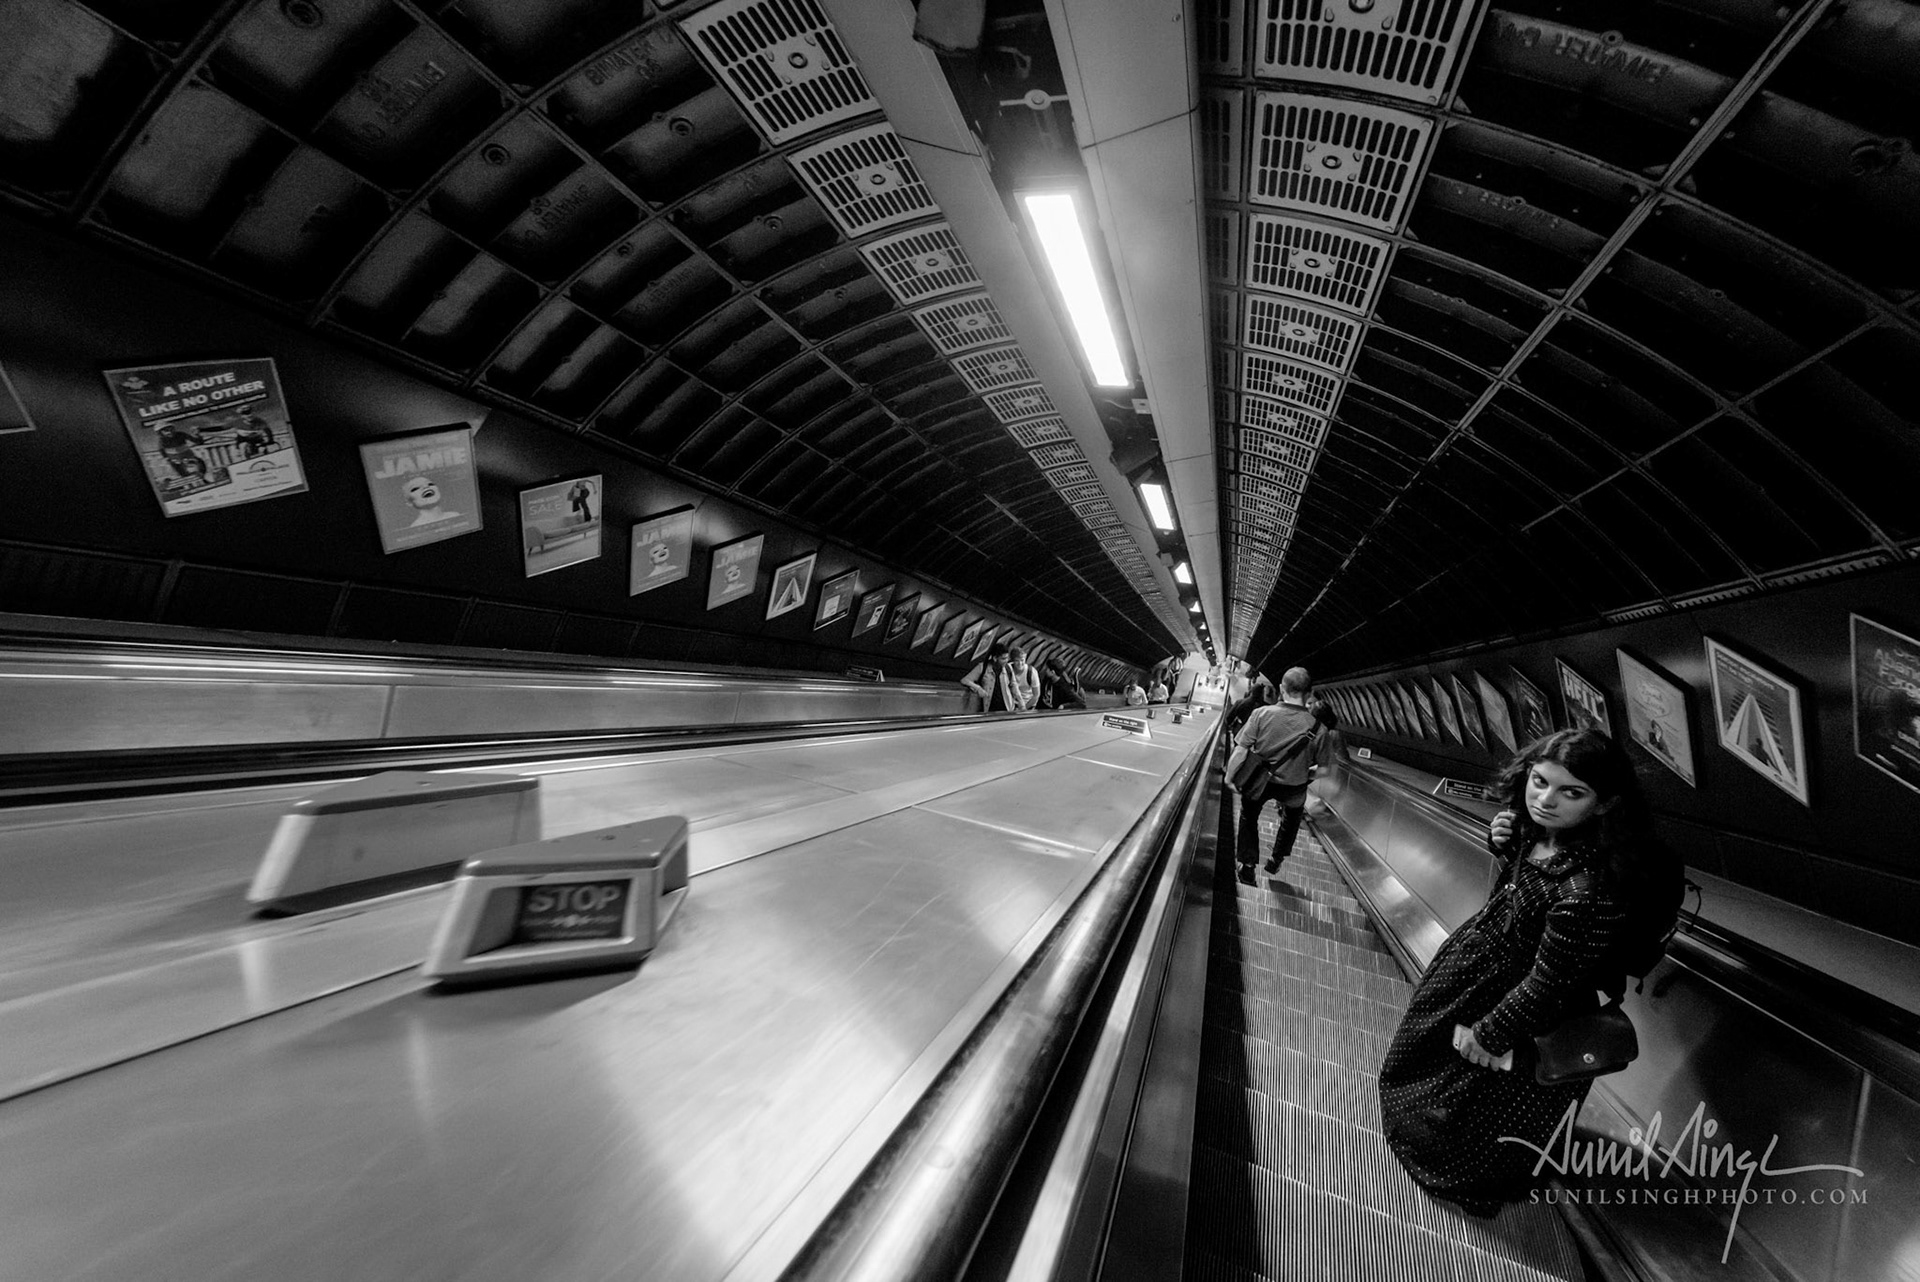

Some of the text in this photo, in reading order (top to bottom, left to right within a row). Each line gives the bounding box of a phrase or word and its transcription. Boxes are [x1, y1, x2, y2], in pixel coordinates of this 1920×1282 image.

[163, 372, 236, 397] A ROUTE
[139, 380, 265, 418] LIKE NO OTHER
[374, 447, 468, 480] JAMIE
[529, 501, 562, 516] SALE
[527, 885, 621, 912] STOP
